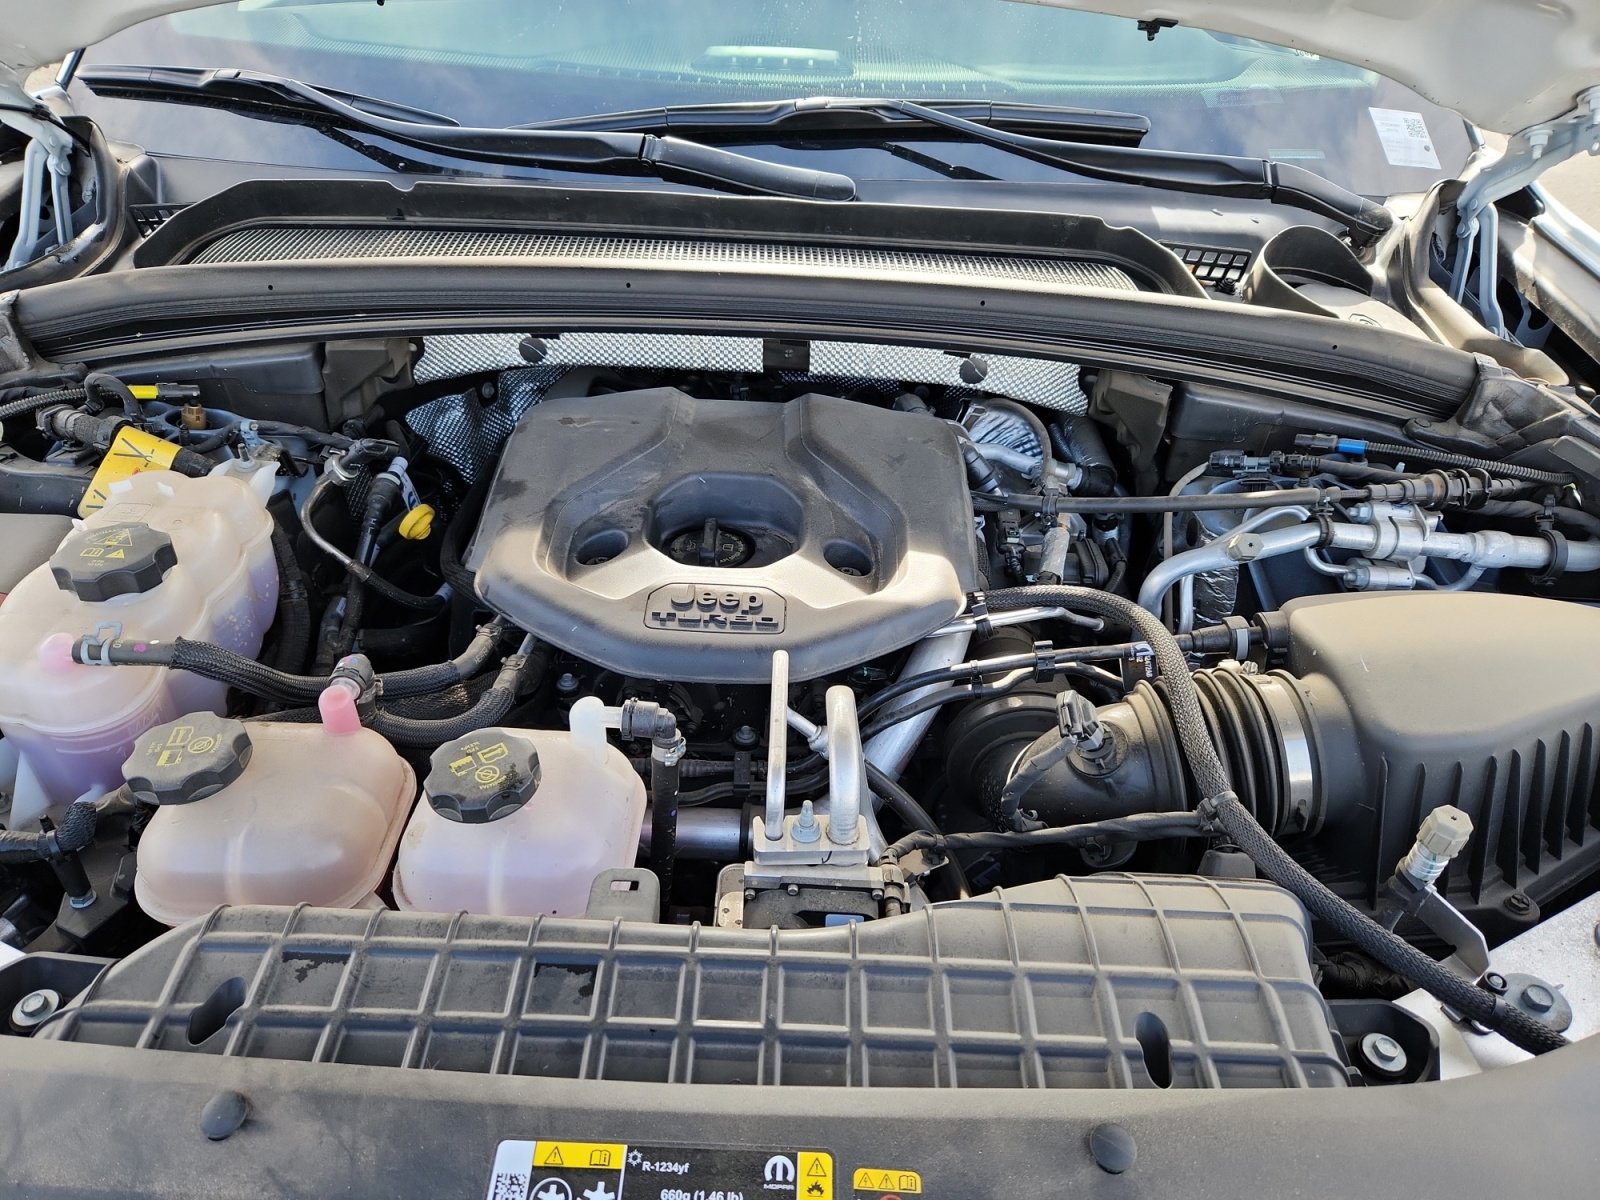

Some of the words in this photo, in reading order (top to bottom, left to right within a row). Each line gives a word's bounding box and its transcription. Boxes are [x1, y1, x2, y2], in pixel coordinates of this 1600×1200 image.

[670, 584, 764, 615] Jeep
[642, 1161, 690, 1175] R-1234yf
[763, 1183, 795, 1191] MOPAR
[660, 1188, 691, 1200] 660g
[693, 1189, 725, 1200] (1.46
[727, 1191, 744, 1200] lb)
